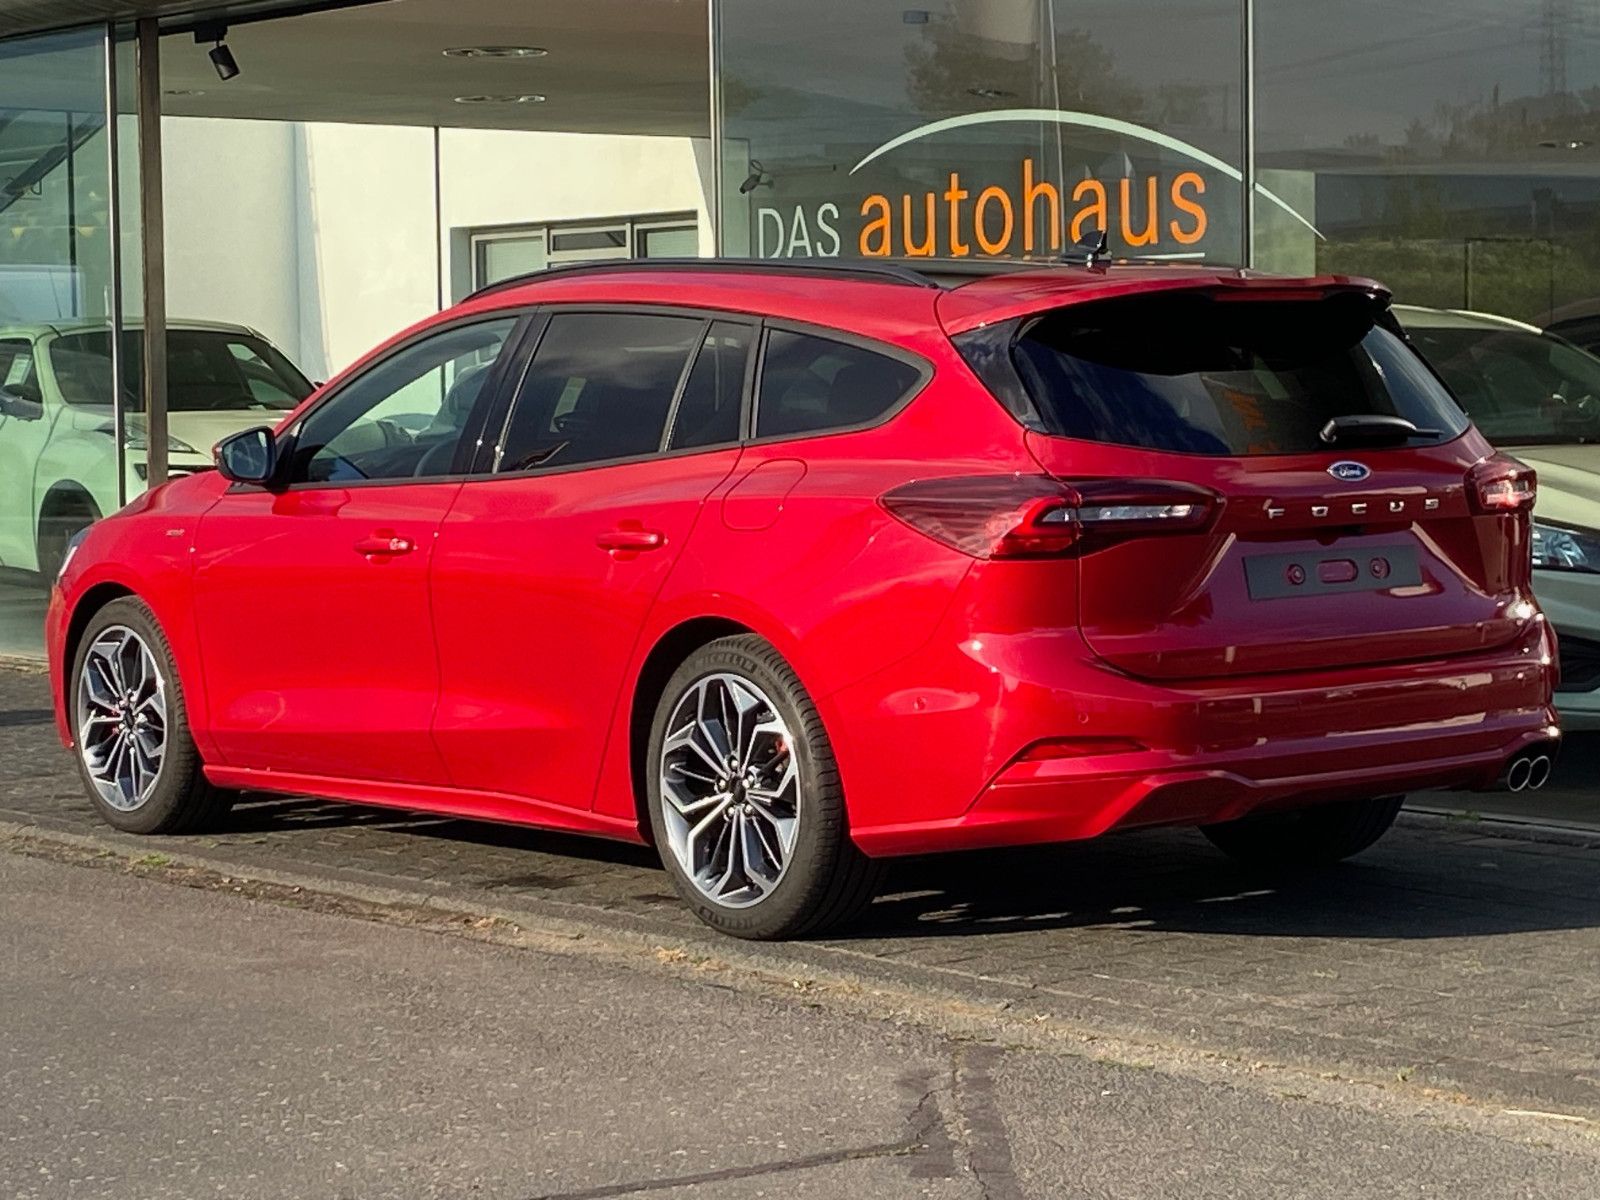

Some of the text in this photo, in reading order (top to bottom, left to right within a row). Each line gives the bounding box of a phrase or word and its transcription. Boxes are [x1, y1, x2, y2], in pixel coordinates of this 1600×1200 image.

[758, 159, 1206, 258] DAS autohaus
[1267, 498, 1440, 518] FOCUS
